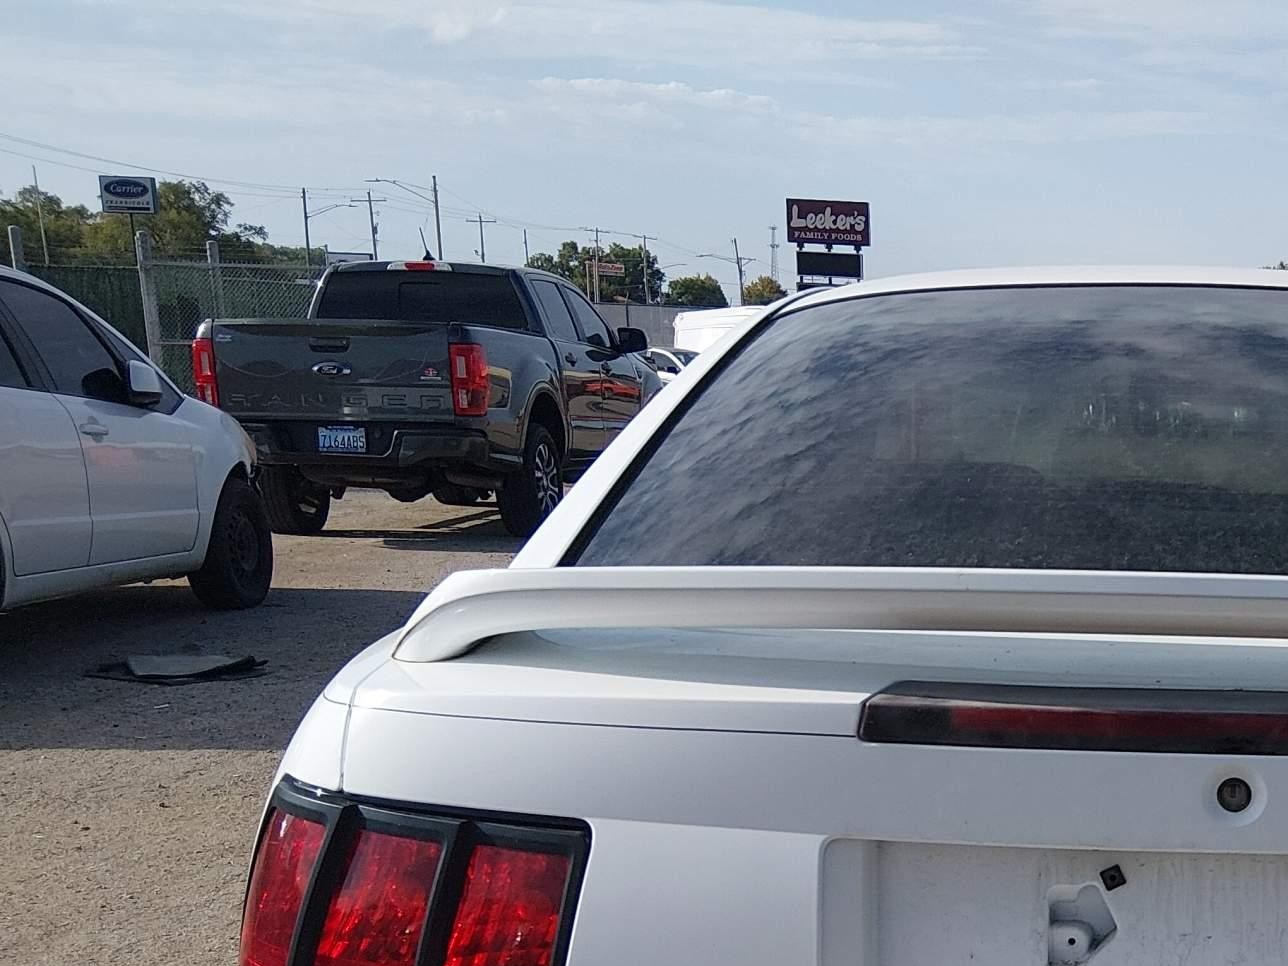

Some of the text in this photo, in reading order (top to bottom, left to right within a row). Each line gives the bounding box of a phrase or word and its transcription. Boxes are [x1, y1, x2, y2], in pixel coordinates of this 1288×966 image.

[110, 183, 144, 193] Carrier
[790, 204, 865, 232] Leeker's
[794, 231, 863, 241] FAMILY FOODS
